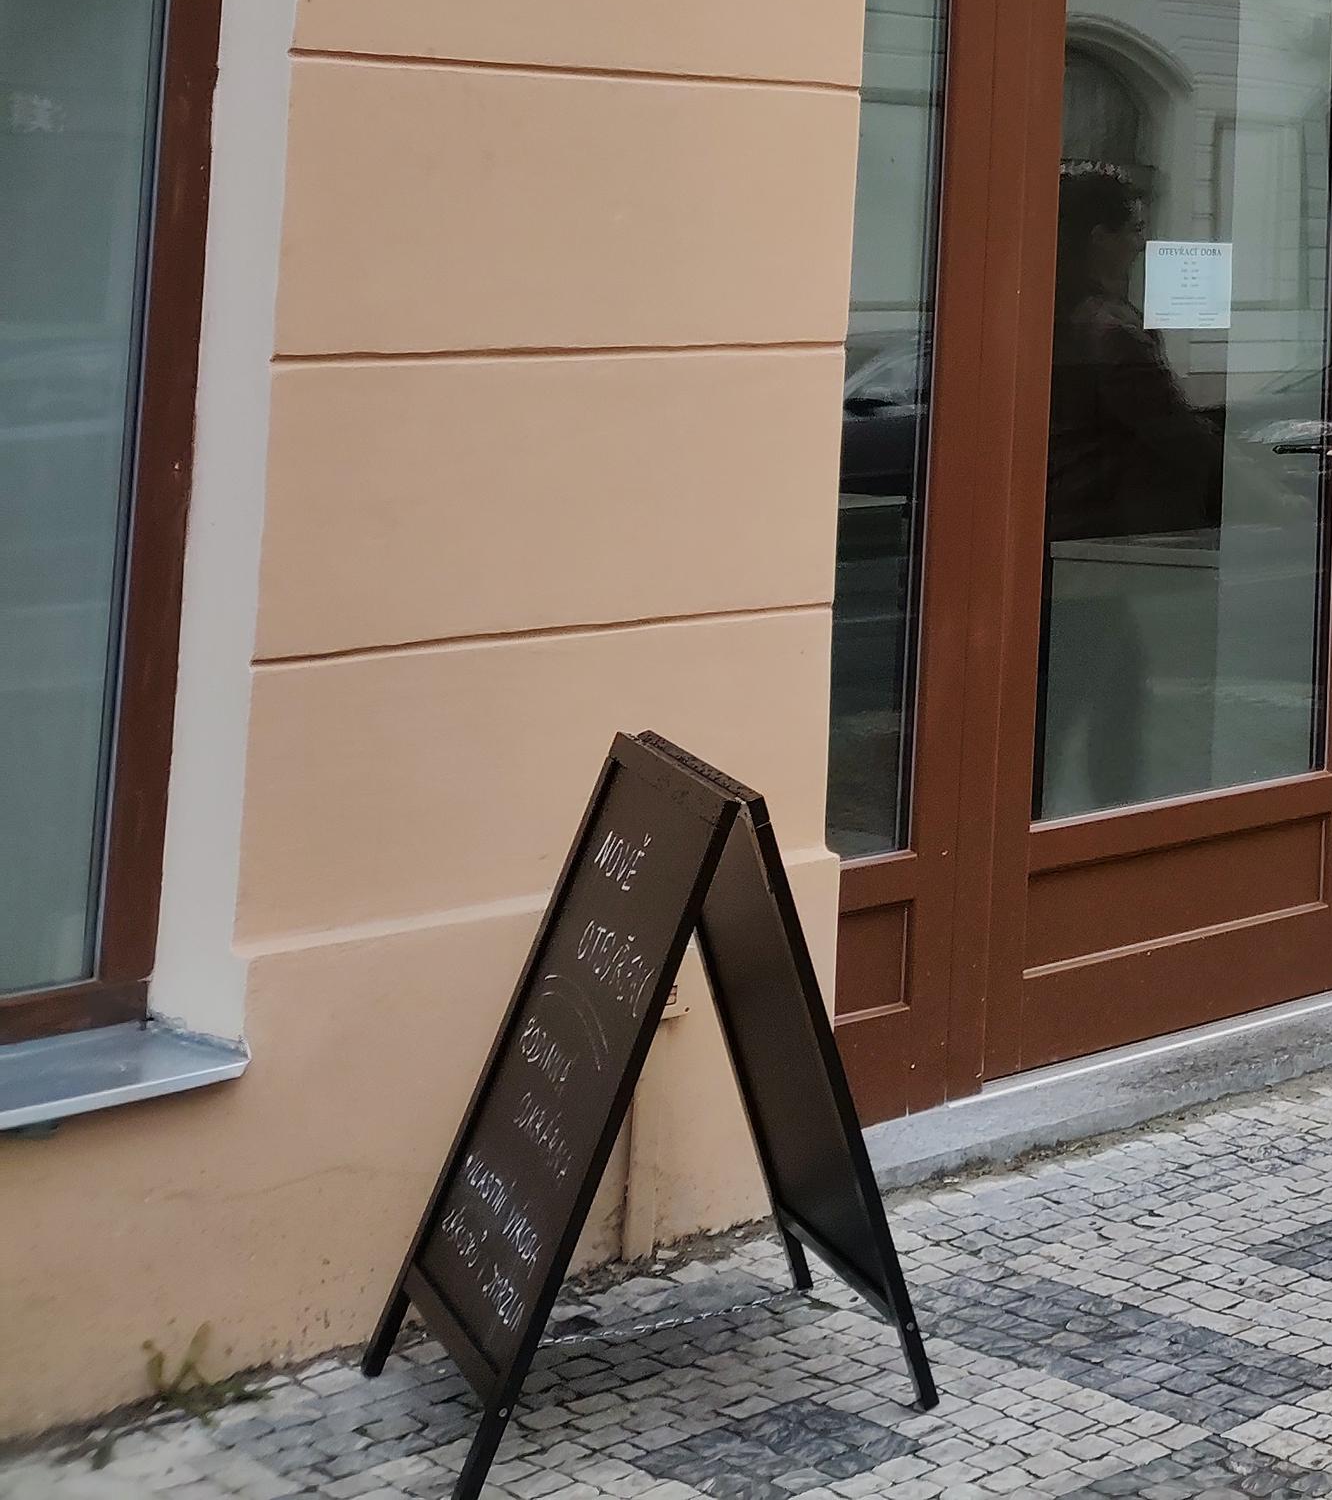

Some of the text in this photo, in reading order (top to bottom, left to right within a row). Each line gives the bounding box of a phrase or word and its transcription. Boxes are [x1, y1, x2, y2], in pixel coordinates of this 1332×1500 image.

[1158, 246, 1222, 257] OTEVŘACÍ DOBA
[594, 831, 652, 891] NOVĚ
[502, 1202, 543, 1280] VÝROBA
